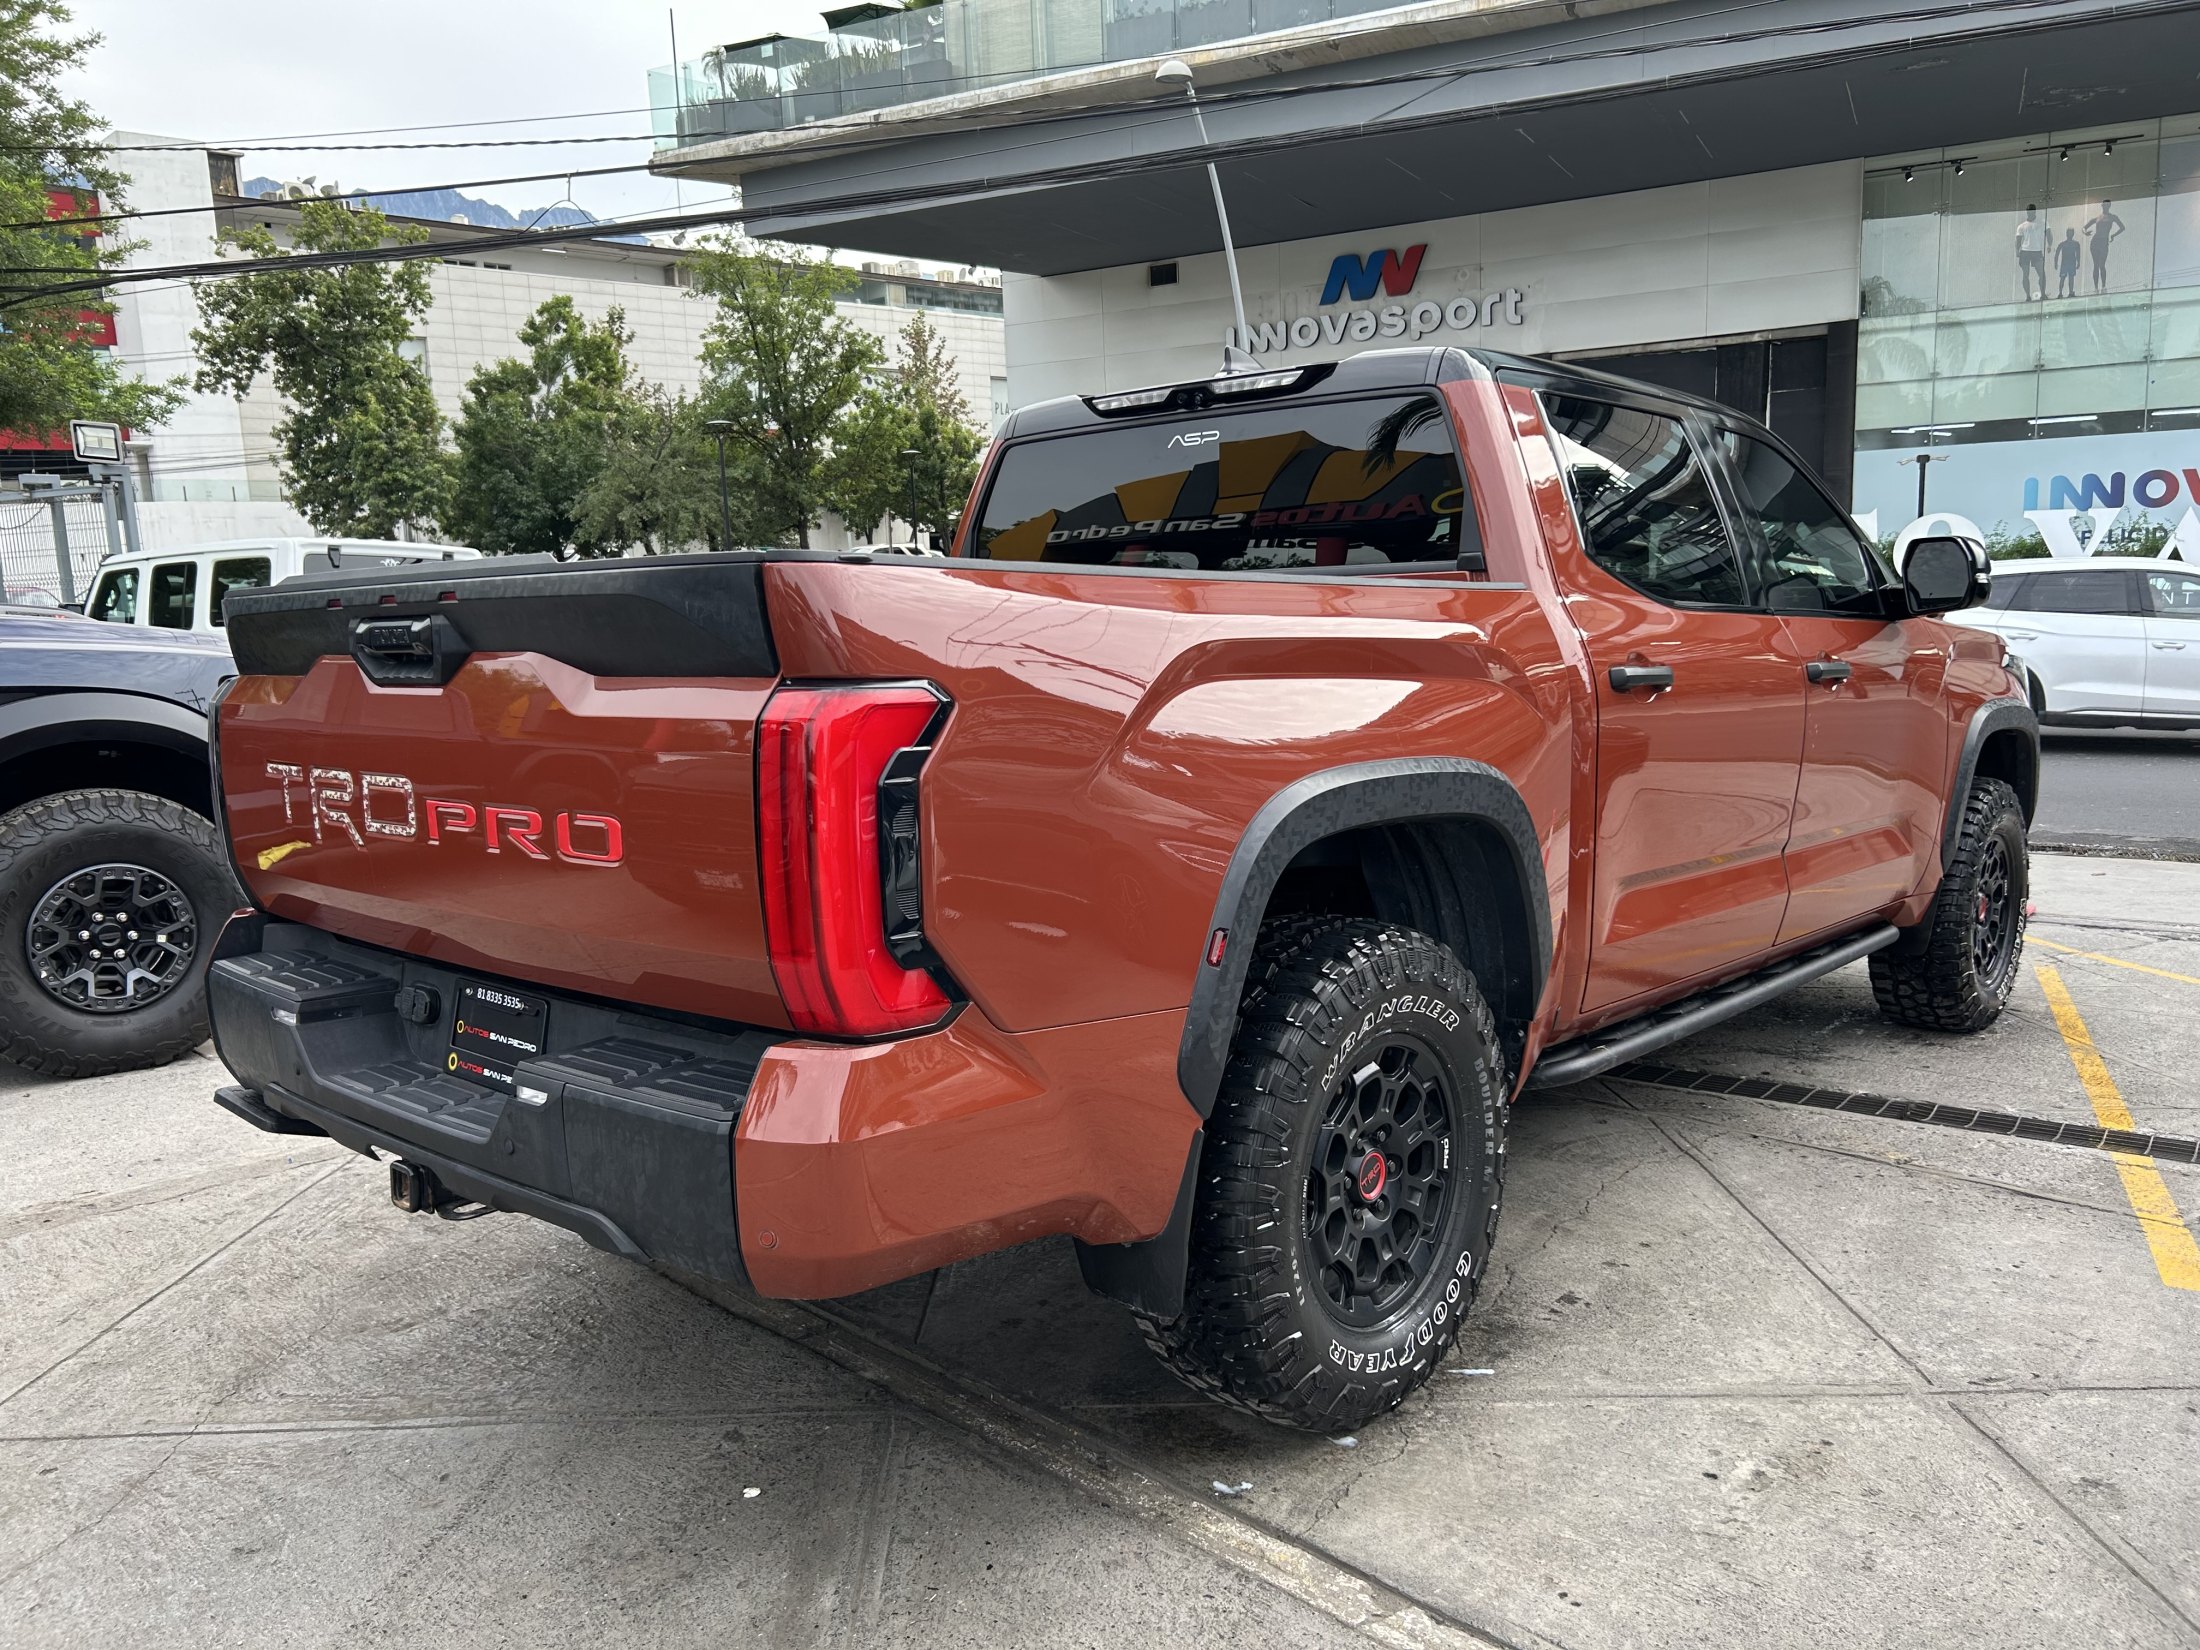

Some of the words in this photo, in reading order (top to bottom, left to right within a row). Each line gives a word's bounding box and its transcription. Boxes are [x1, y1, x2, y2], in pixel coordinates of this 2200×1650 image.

[994, 402, 1017, 415] PLA
[1167, 430, 1220, 448] ASP
[265, 761, 417, 851] TRD
[425, 799, 624, 867] PRO
[477, 988, 486, 1000] 81
[487, 991, 503, 1004] 8335
[503, 993, 520, 1009] 3535
[464, 1025, 490, 1038] AUTOS
[489, 1032, 507, 1044] SAN
[507, 1038, 537, 1052] PEDRO
[1321, 995, 1460, 1091] WRANGLER
[458, 1061, 484, 1074] AUTOS
[483, 1068, 501, 1080] SAN
[1474, 1057, 1495, 1155] BOULDER
[1329, 1250, 1472, 1374] GOODYEAR
